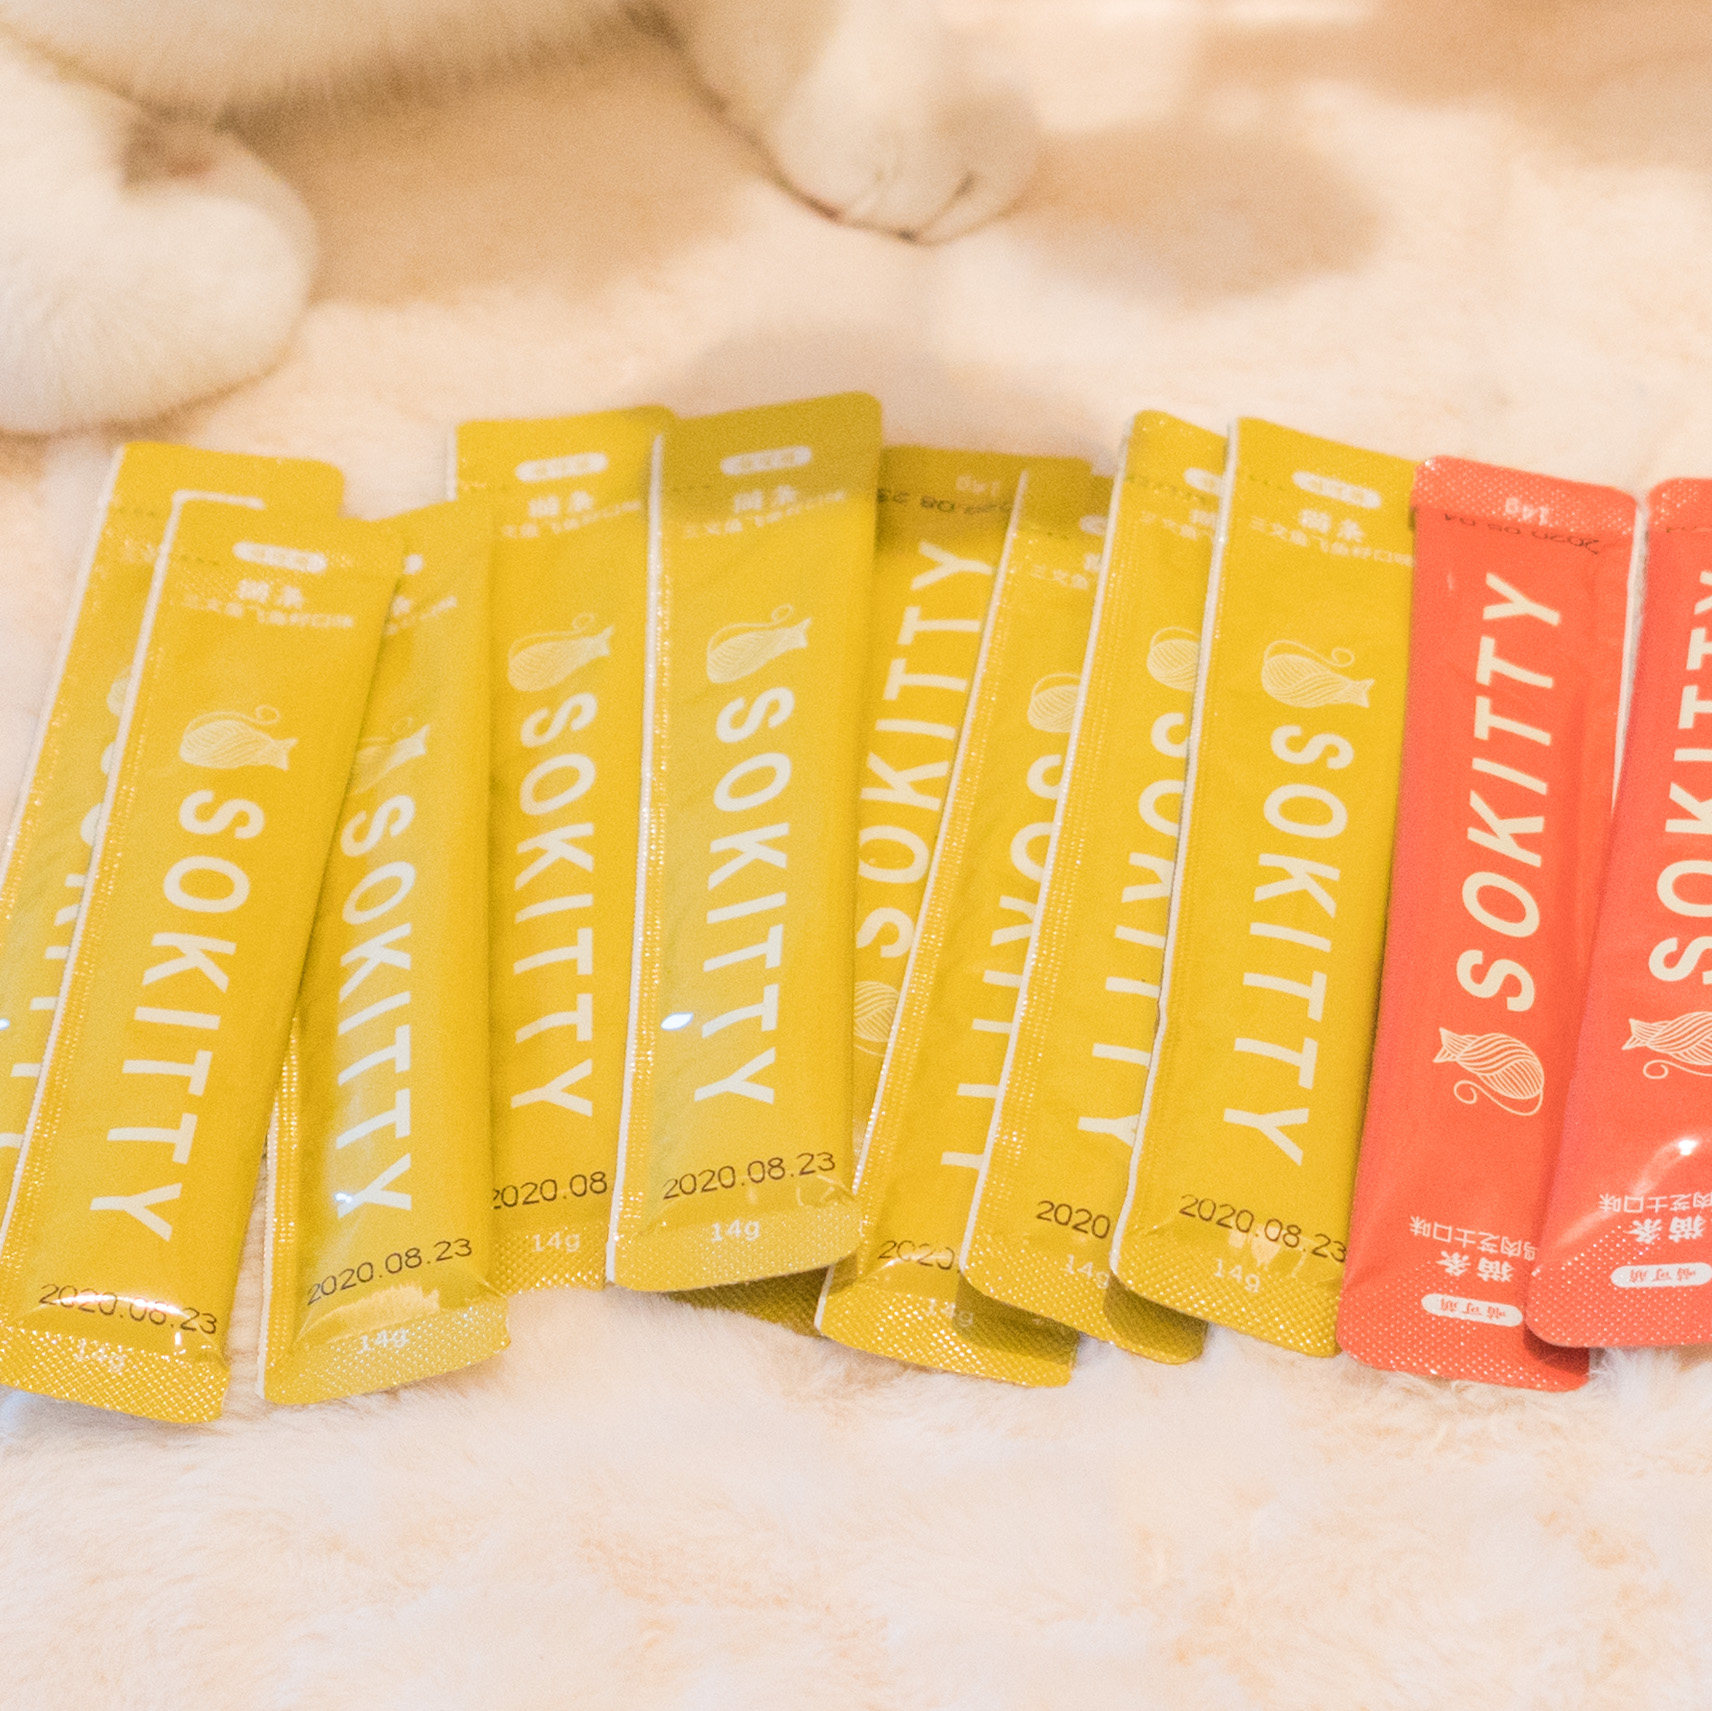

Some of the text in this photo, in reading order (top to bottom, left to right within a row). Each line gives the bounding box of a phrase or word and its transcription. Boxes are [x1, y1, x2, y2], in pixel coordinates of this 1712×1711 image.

[511, 693, 598, 1117] SOKITTY
[694, 687, 795, 1105] SOKITTY
[856, 541, 998, 959] SOKITTY
[1223, 725, 1354, 1166] SOKITTY
[1455, 572, 1561, 1013] SOKITTY
[90, 789, 266, 1242] SOKITTY
[335, 795, 416, 1220] SOKITTY
[662, 1151, 837, 1200] 2020.08.23
[306, 1237, 473, 1306] 2020.08.23
[1179, 1194, 1347, 1263] 2020.08.23
[1436, 1248, 1514, 1282] 猫条
[1628, 1215, 1708, 1244] 猫条
